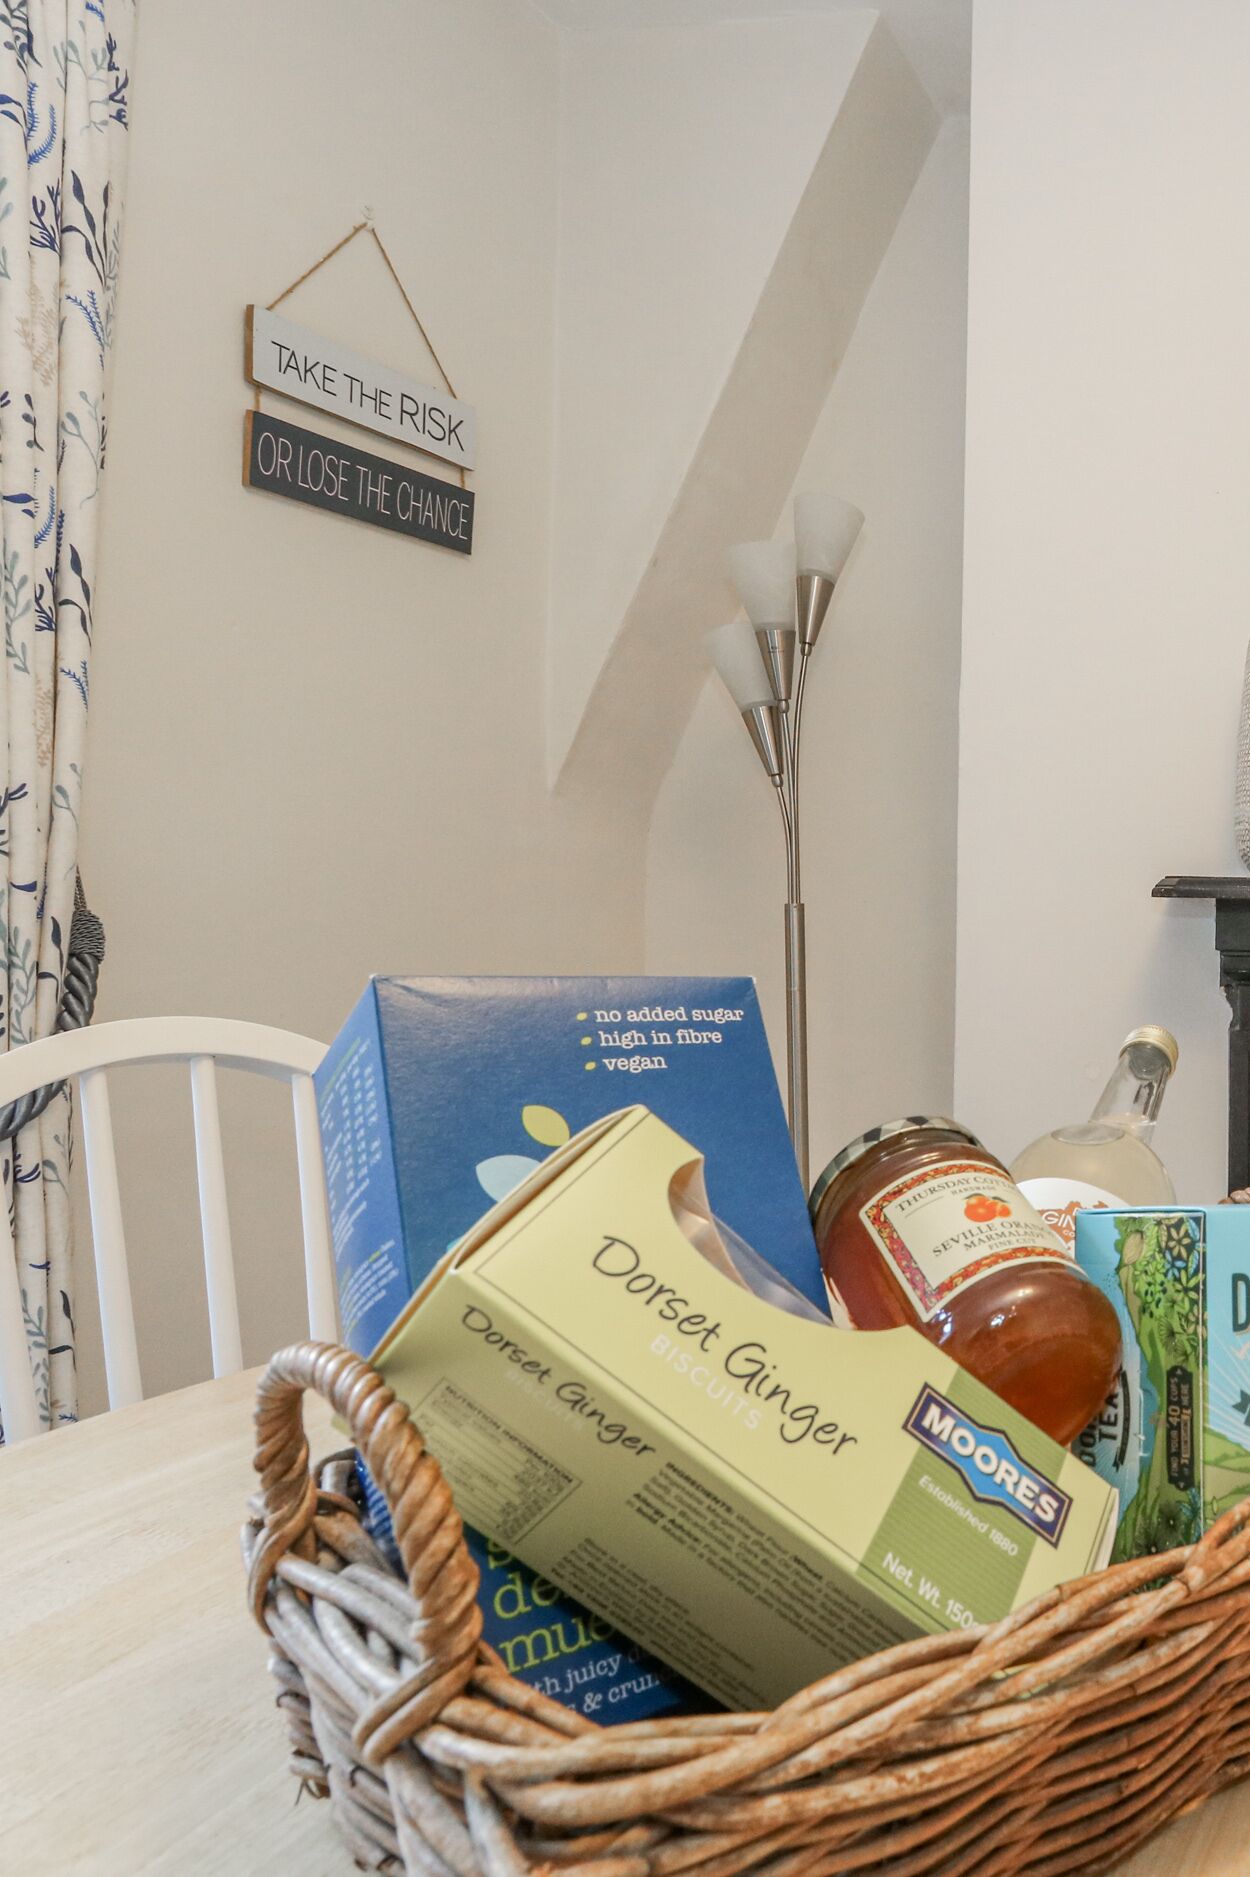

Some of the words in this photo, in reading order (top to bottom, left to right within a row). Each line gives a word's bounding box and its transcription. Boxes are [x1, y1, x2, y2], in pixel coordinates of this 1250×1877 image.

[271, 340, 337, 397] TAKE
[343, 373, 392, 421] THE
[400, 393, 465, 452] RISK
[258, 432, 292, 482] OR
[298, 445, 351, 501] LOSE
[356, 465, 393, 515] THE
[397, 482, 470, 540] CHANCE
[594, 1009, 621, 1022] no
[627, 1007, 688, 1022] added
[692, 1008, 744, 1024] sugar
[598, 1030, 648, 1049] high
[651, 1030, 673, 1045] in
[676, 1029, 723, 1045] fibre
[603, 1055, 668, 1073] vegan
[895, 1178, 970, 1213] THURSDAY
[973, 1175, 1020, 1191] COTT
[932, 1221, 998, 1258] SEVILLE
[963, 1229, 1047, 1252] MARMALADE
[1042, 1211, 1075, 1231] GIN
[988, 1240, 1014, 1252] FINE
[1016, 1237, 1038, 1247] CUT
[592, 1235, 721, 1352] Dorset
[724, 1342, 857, 1455] Ginger
[461, 1304, 552, 1384] Dorset
[555, 1381, 656, 1457] Ginger
[650, 1333, 763, 1430] BISCUITS
[445, 1385, 501, 1430] NUTRITION
[501, 1428, 574, 1484] INFORMATION
[1168, 1405, 1180, 1426] 40
[921, 1402, 1060, 1523] MOORES
[918, 1475, 988, 1534] Established
[987, 1529, 1019, 1557] 1880
[494, 1571, 560, 1620] de
[883, 1552, 914, 1589] Net.
[917, 1574, 943, 1608] Wt.
[500, 1613, 616, 1673] mue
[564, 1653, 622, 1693] juicy
[583, 1692, 603, 1713] &
